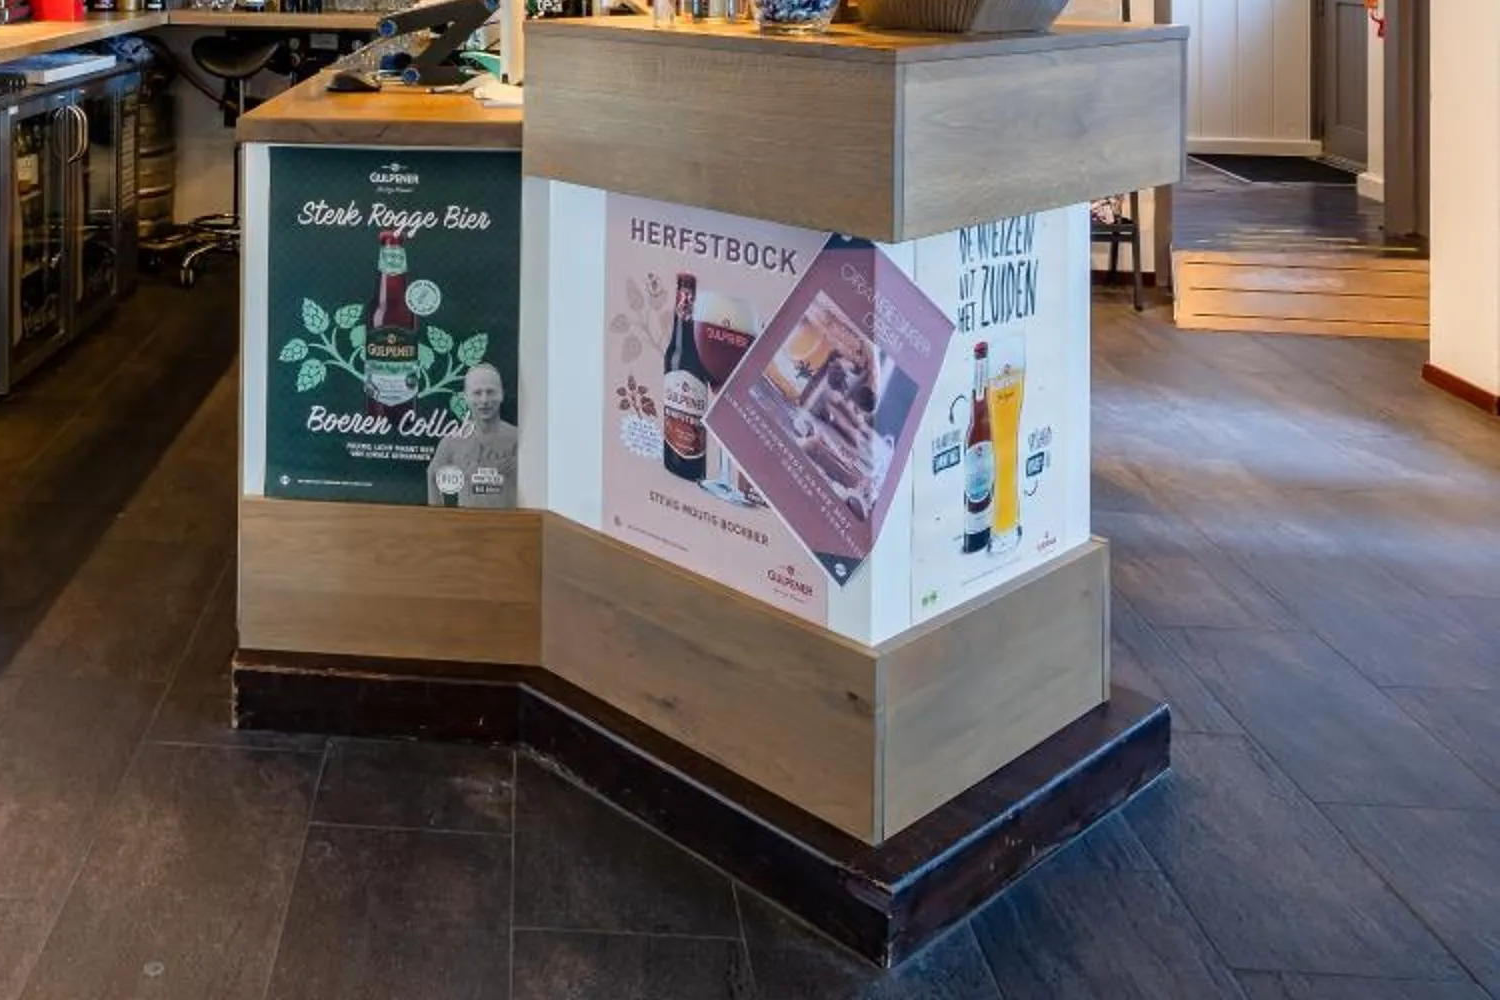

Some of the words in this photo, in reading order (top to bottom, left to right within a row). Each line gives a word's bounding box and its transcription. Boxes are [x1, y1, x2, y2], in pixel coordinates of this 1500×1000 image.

[297, 199, 363, 226] Sterk
[367, 203, 439, 238] Rogge
[443, 205, 491, 230] Bier
[631, 217, 797, 275] HERFSTBOCK
[981, 259, 1040, 327] ZUIDEN
[958, 301, 977, 335] HET
[306, 404, 393, 434] Boeren
[398, 409, 476, 439] Collab
